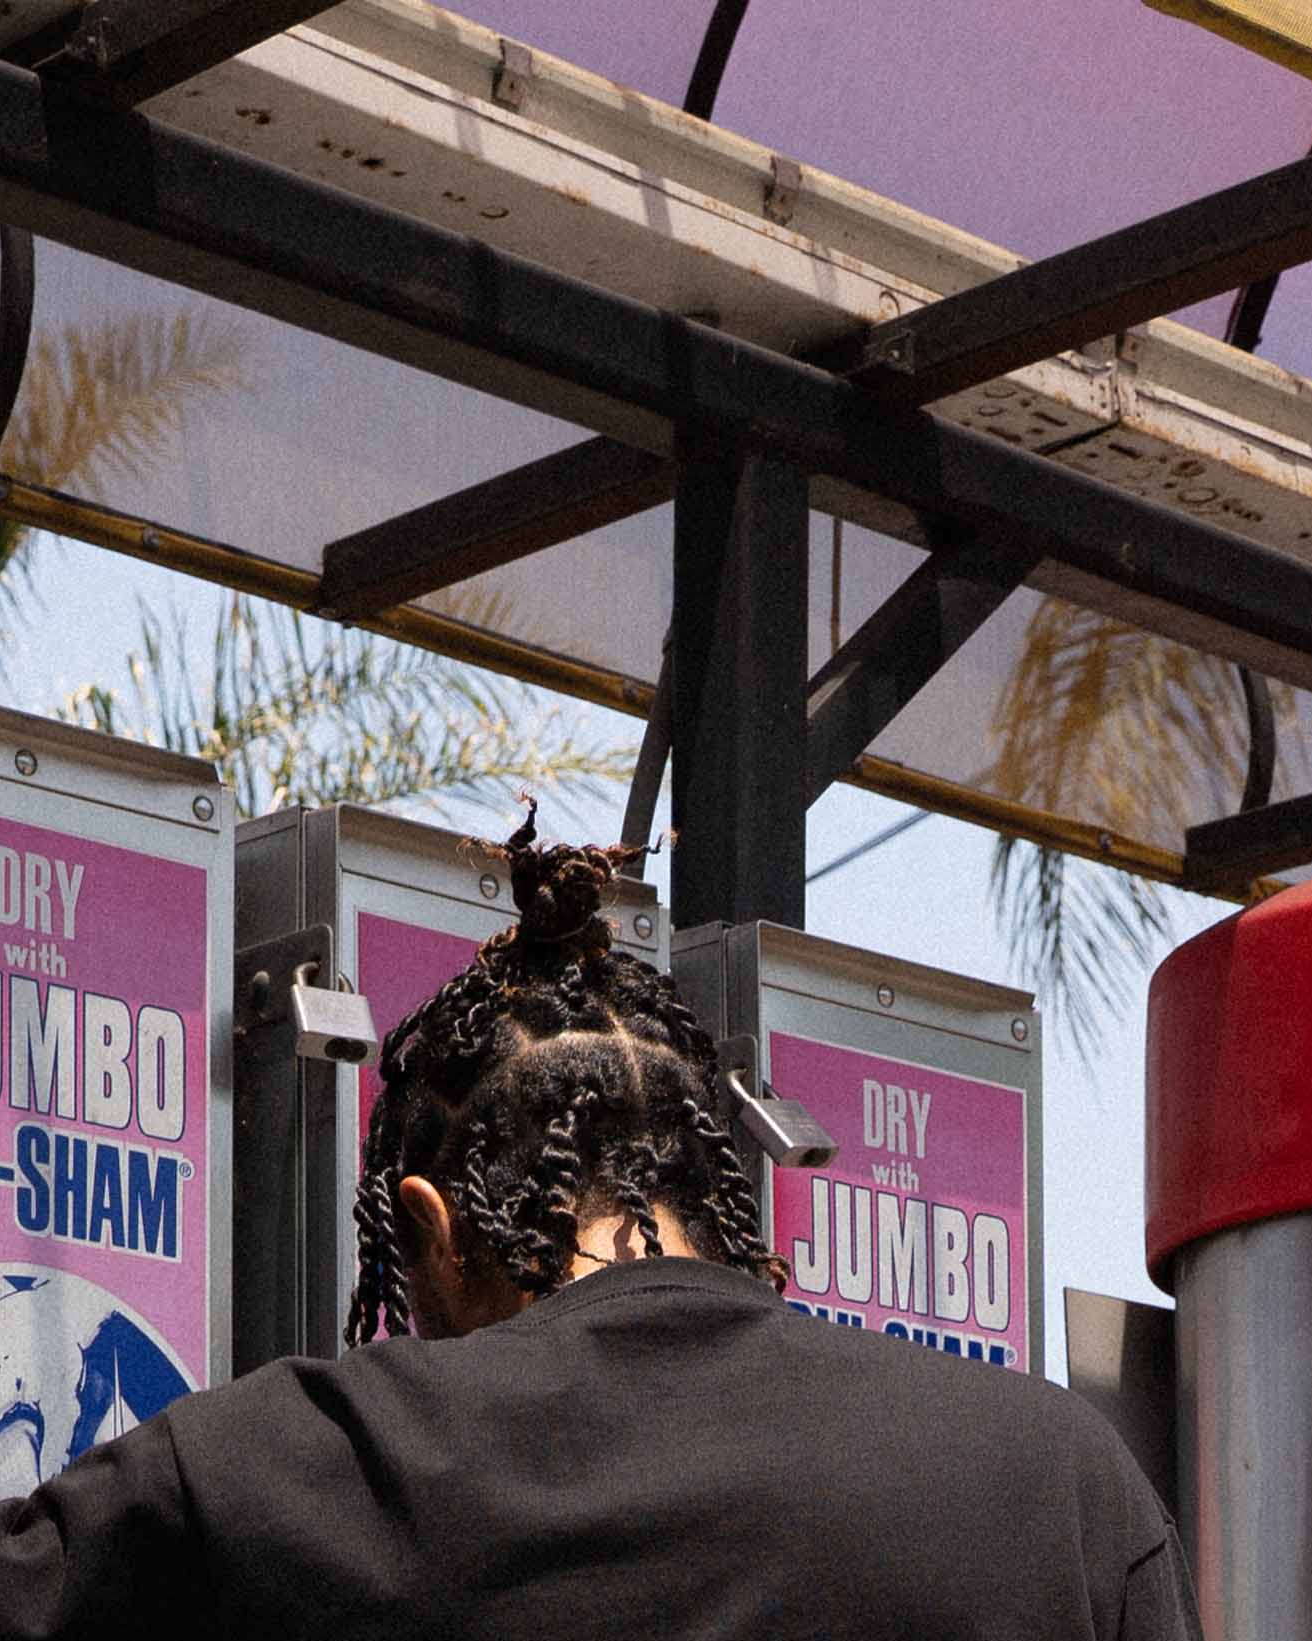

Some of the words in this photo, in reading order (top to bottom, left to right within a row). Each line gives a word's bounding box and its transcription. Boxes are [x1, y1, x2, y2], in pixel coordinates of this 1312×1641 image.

[3, 940, 68, 978] with
[863, 1079, 931, 1159] DRY
[872, 1161, 919, 1192] with
[793, 1176, 1010, 1332] JUMBO
